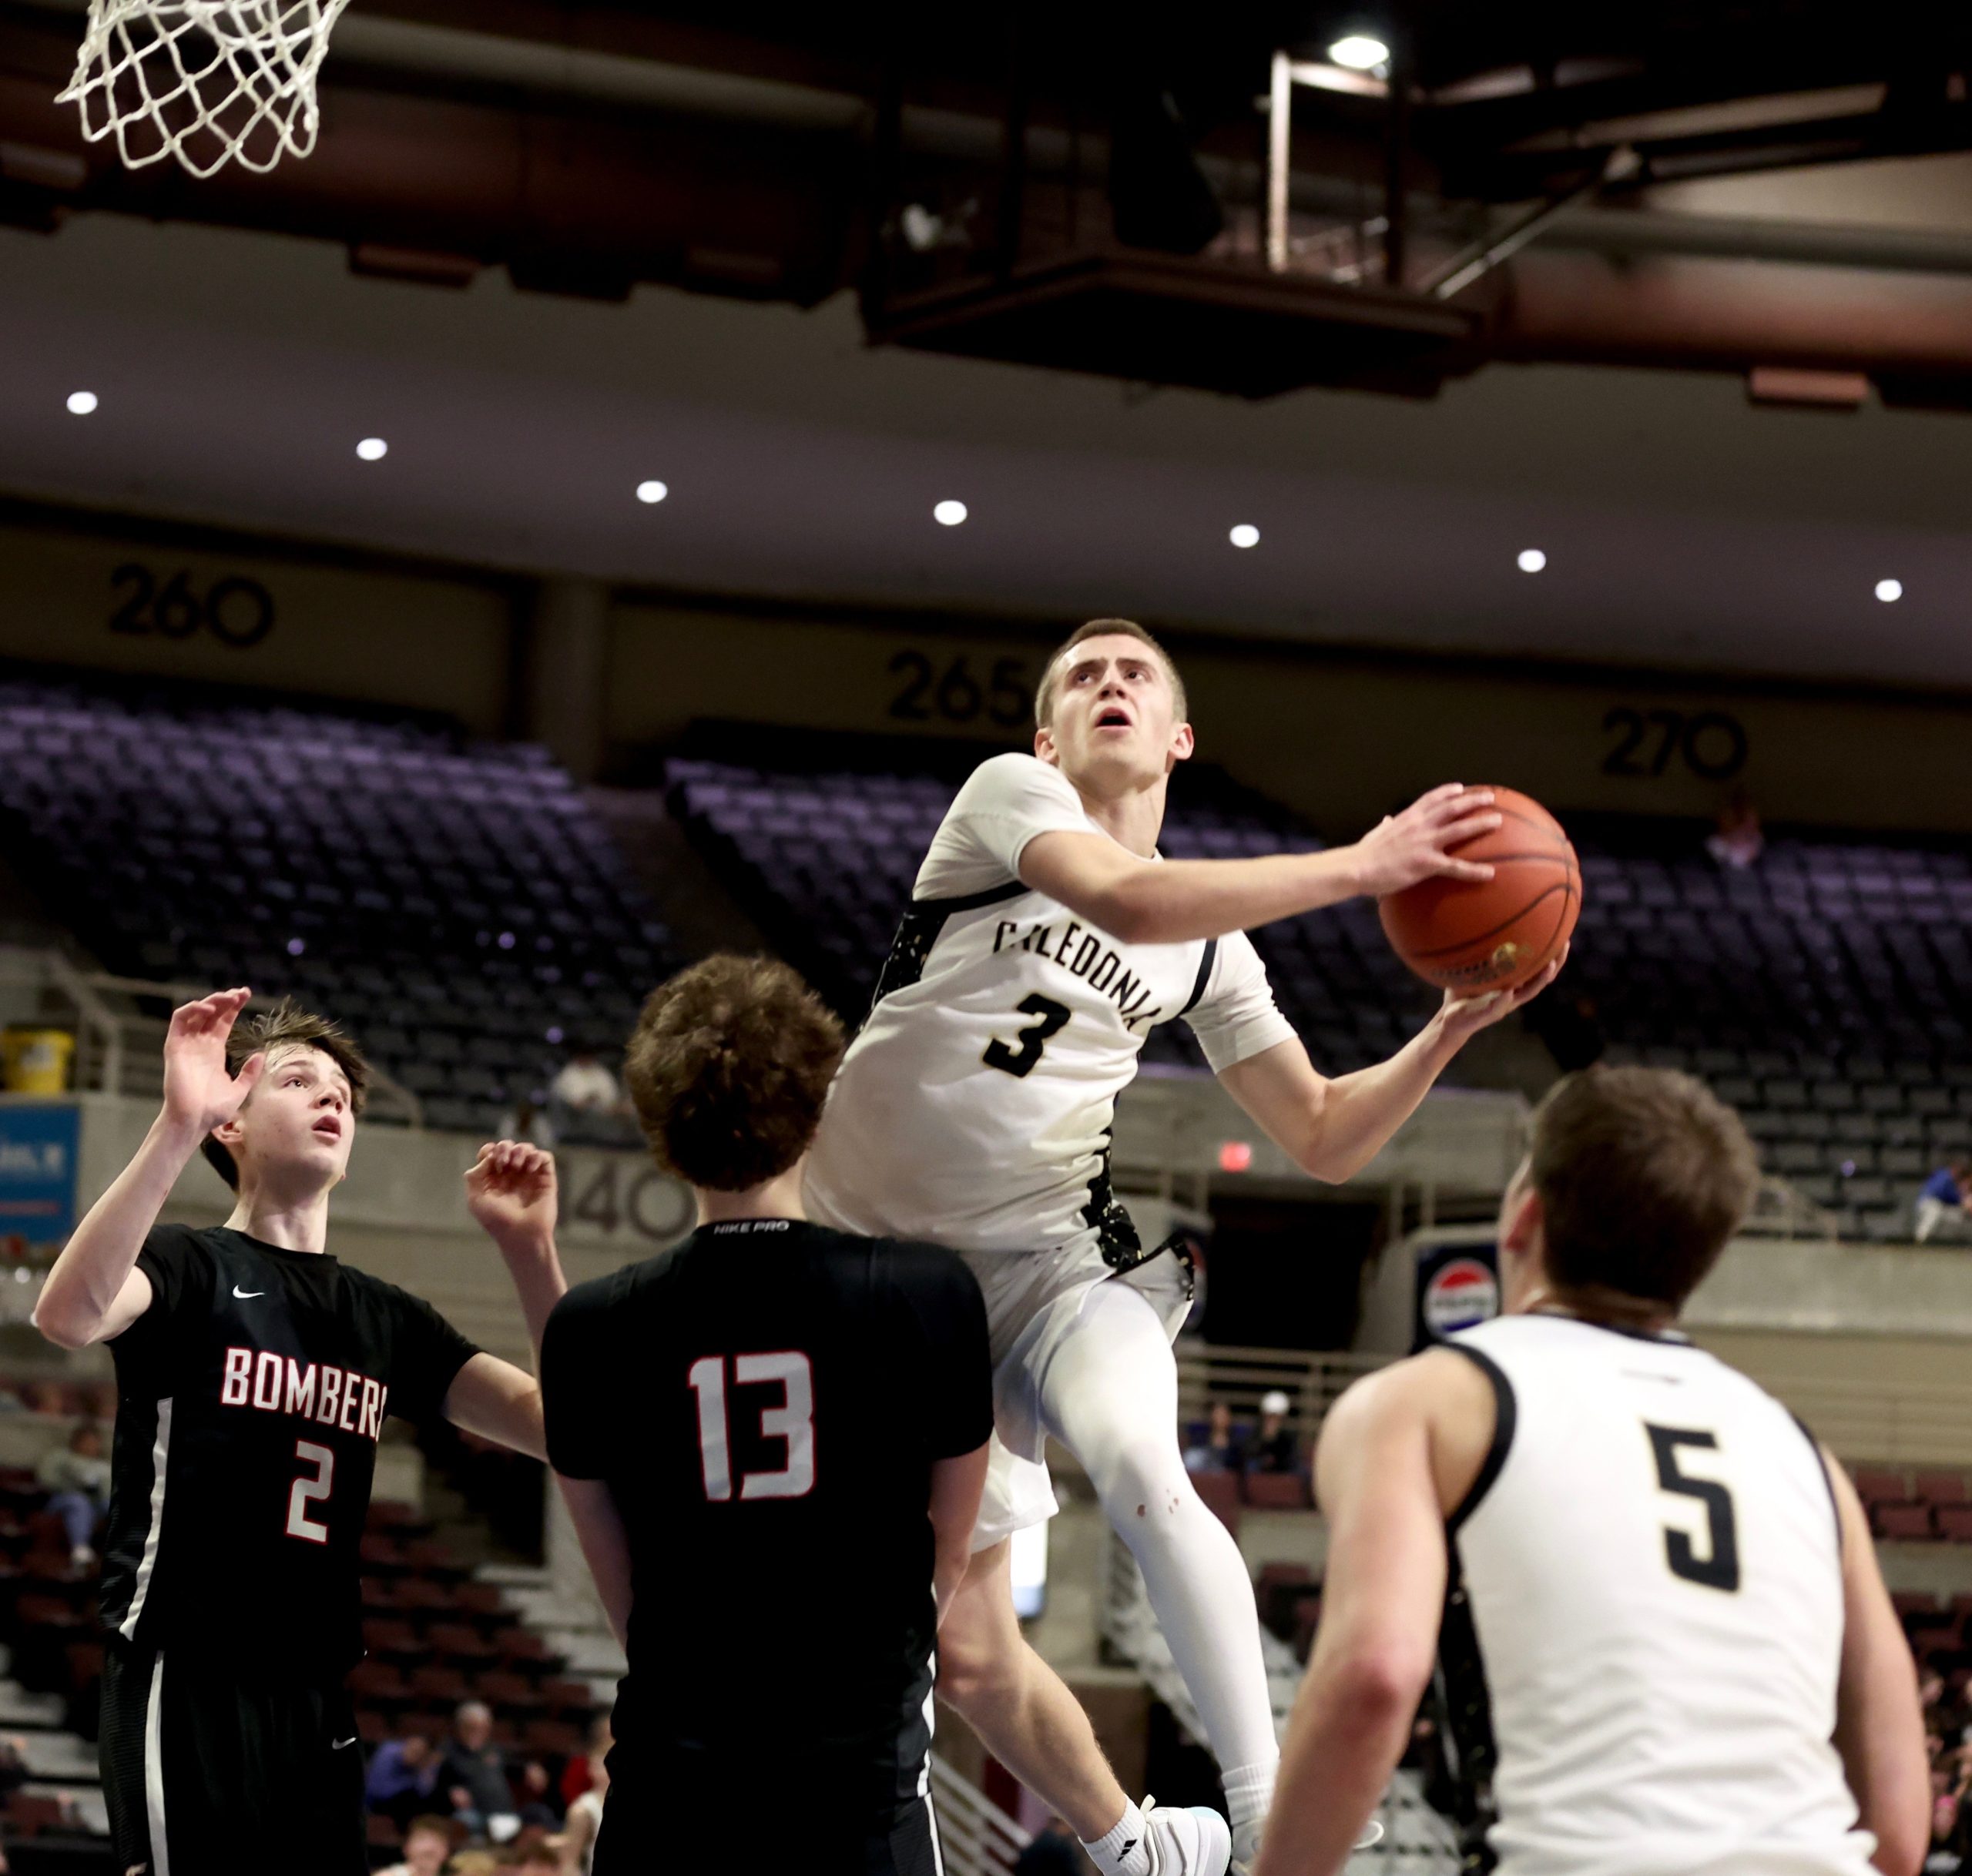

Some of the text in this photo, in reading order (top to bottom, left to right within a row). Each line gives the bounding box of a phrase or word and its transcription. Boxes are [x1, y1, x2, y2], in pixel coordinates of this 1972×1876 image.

[111, 565, 273, 645] 260
[890, 652, 1030, 725] 265
[1605, 708, 1746, 778] 270
[982, 993, 1072, 1078] 3
[713, 1220, 790, 1235] NIKE PRO
[221, 1347, 387, 1442] BOMBER
[687, 1350, 816, 1502] 13
[285, 1439, 334, 1545] 2
[1641, 1419, 1740, 1594] 5
